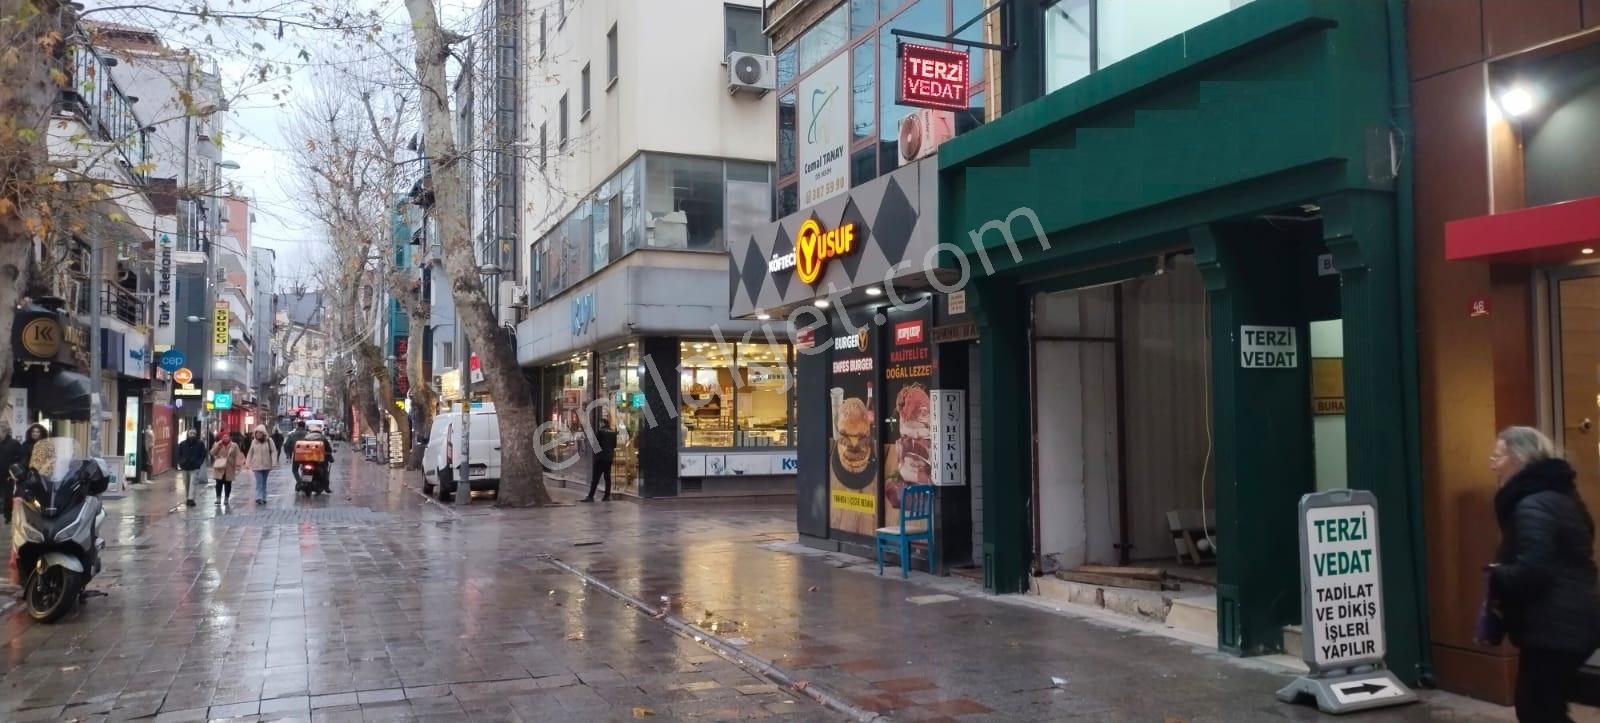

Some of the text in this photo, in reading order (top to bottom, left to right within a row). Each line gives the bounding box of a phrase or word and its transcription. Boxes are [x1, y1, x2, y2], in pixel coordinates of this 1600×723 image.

[909, 57, 963, 82] TERZİ
[908, 77, 964, 100] VEDAT
[804, 145, 844, 174] Cemal TANAY
[768, 223, 855, 275] KÖFTECİ YUSUF
[159, 246, 171, 328] Türk Telekom
[1473, 301, 1485, 311] 46
[835, 334, 859, 350] BURGER
[1245, 328, 1291, 346] TERZİ
[850, 358, 873, 371] BURGER
[1243, 352, 1295, 367] VEDAT
[886, 364, 909, 379] DOĞAL
[1314, 511, 1367, 543] TERZİ
[1313, 549, 1372, 577] VEDAT
[1316, 582, 1374, 602] TADİLAT
[1316, 600, 1376, 621] VE DİKİŞ
[1325, 619, 1369, 643] İŞLERİ
[1322, 640, 1375, 660] YAPILIR
